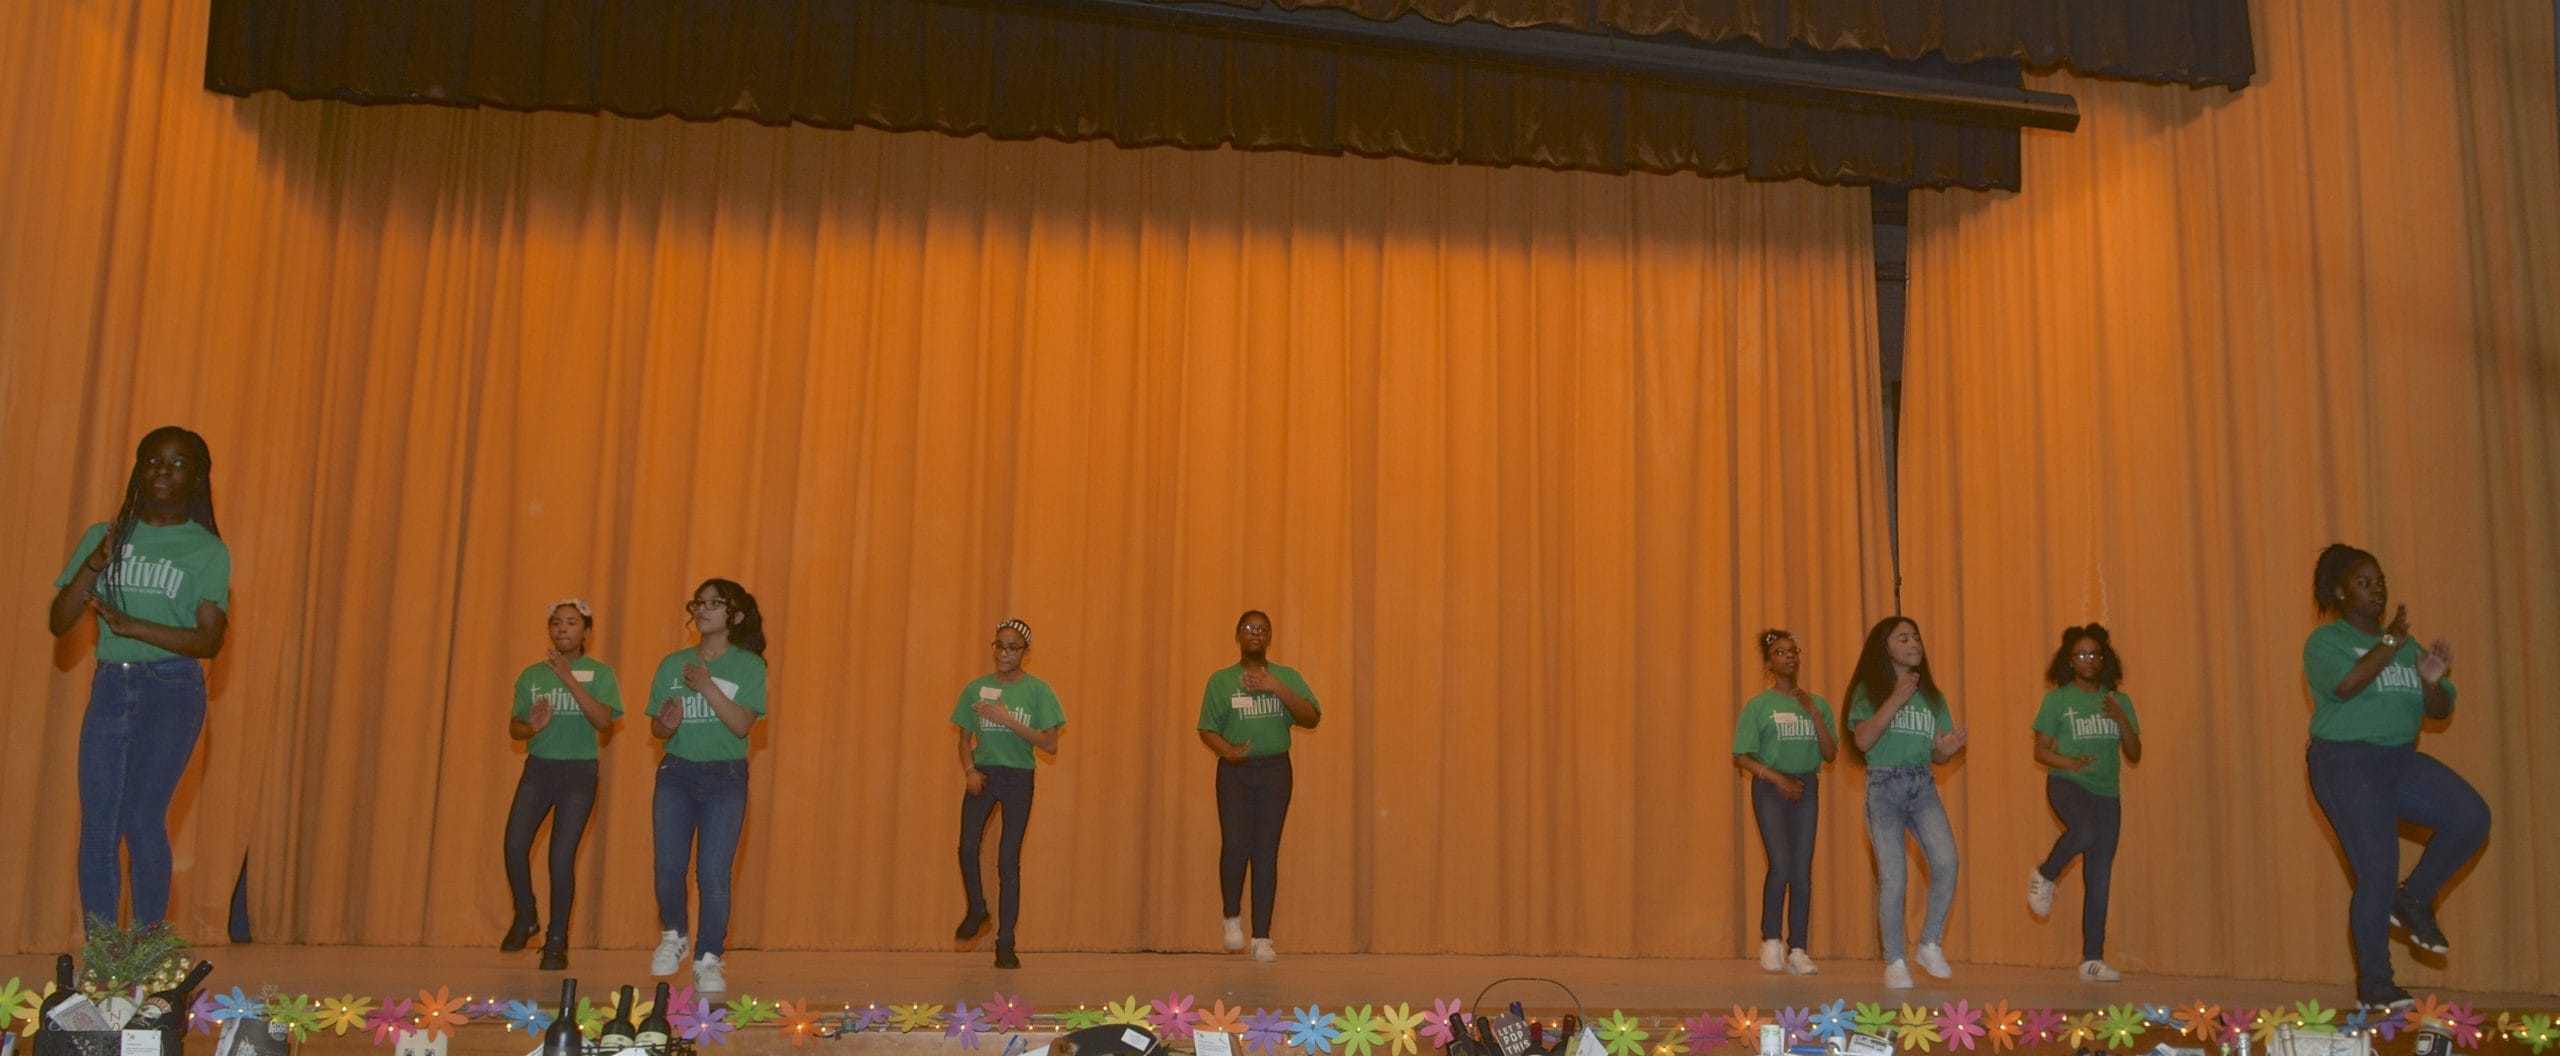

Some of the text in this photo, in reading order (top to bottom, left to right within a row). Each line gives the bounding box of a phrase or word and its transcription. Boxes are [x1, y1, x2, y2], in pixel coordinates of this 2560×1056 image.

[1497, 1022, 1522, 1037] LET'S
[1503, 1030, 1523, 1046] POP
[1506, 1039, 1531, 1055] THIS
